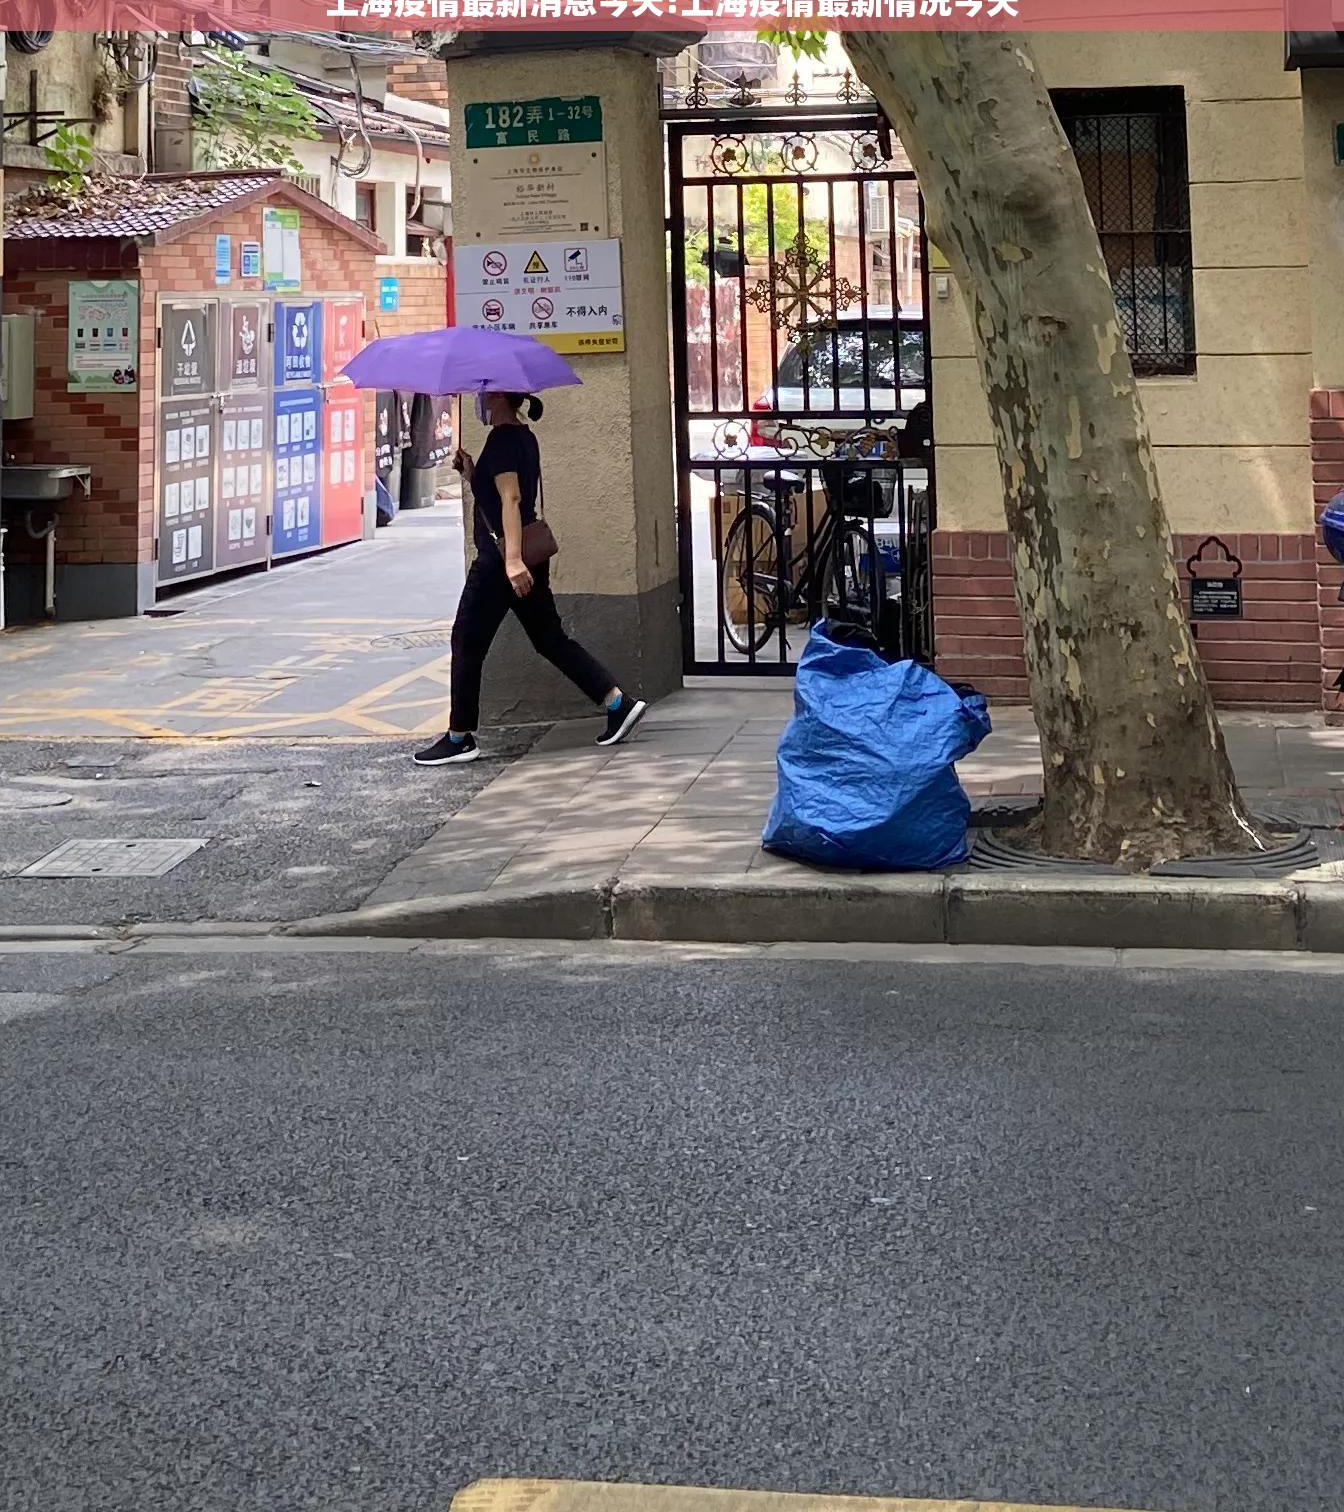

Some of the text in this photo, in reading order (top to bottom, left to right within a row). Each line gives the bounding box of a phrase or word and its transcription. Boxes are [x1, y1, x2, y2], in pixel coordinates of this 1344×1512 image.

[485, 105, 543, 129] 182弄
[495, 128, 571, 145] 富民路
[566, 305, 608, 317] 不得入内
